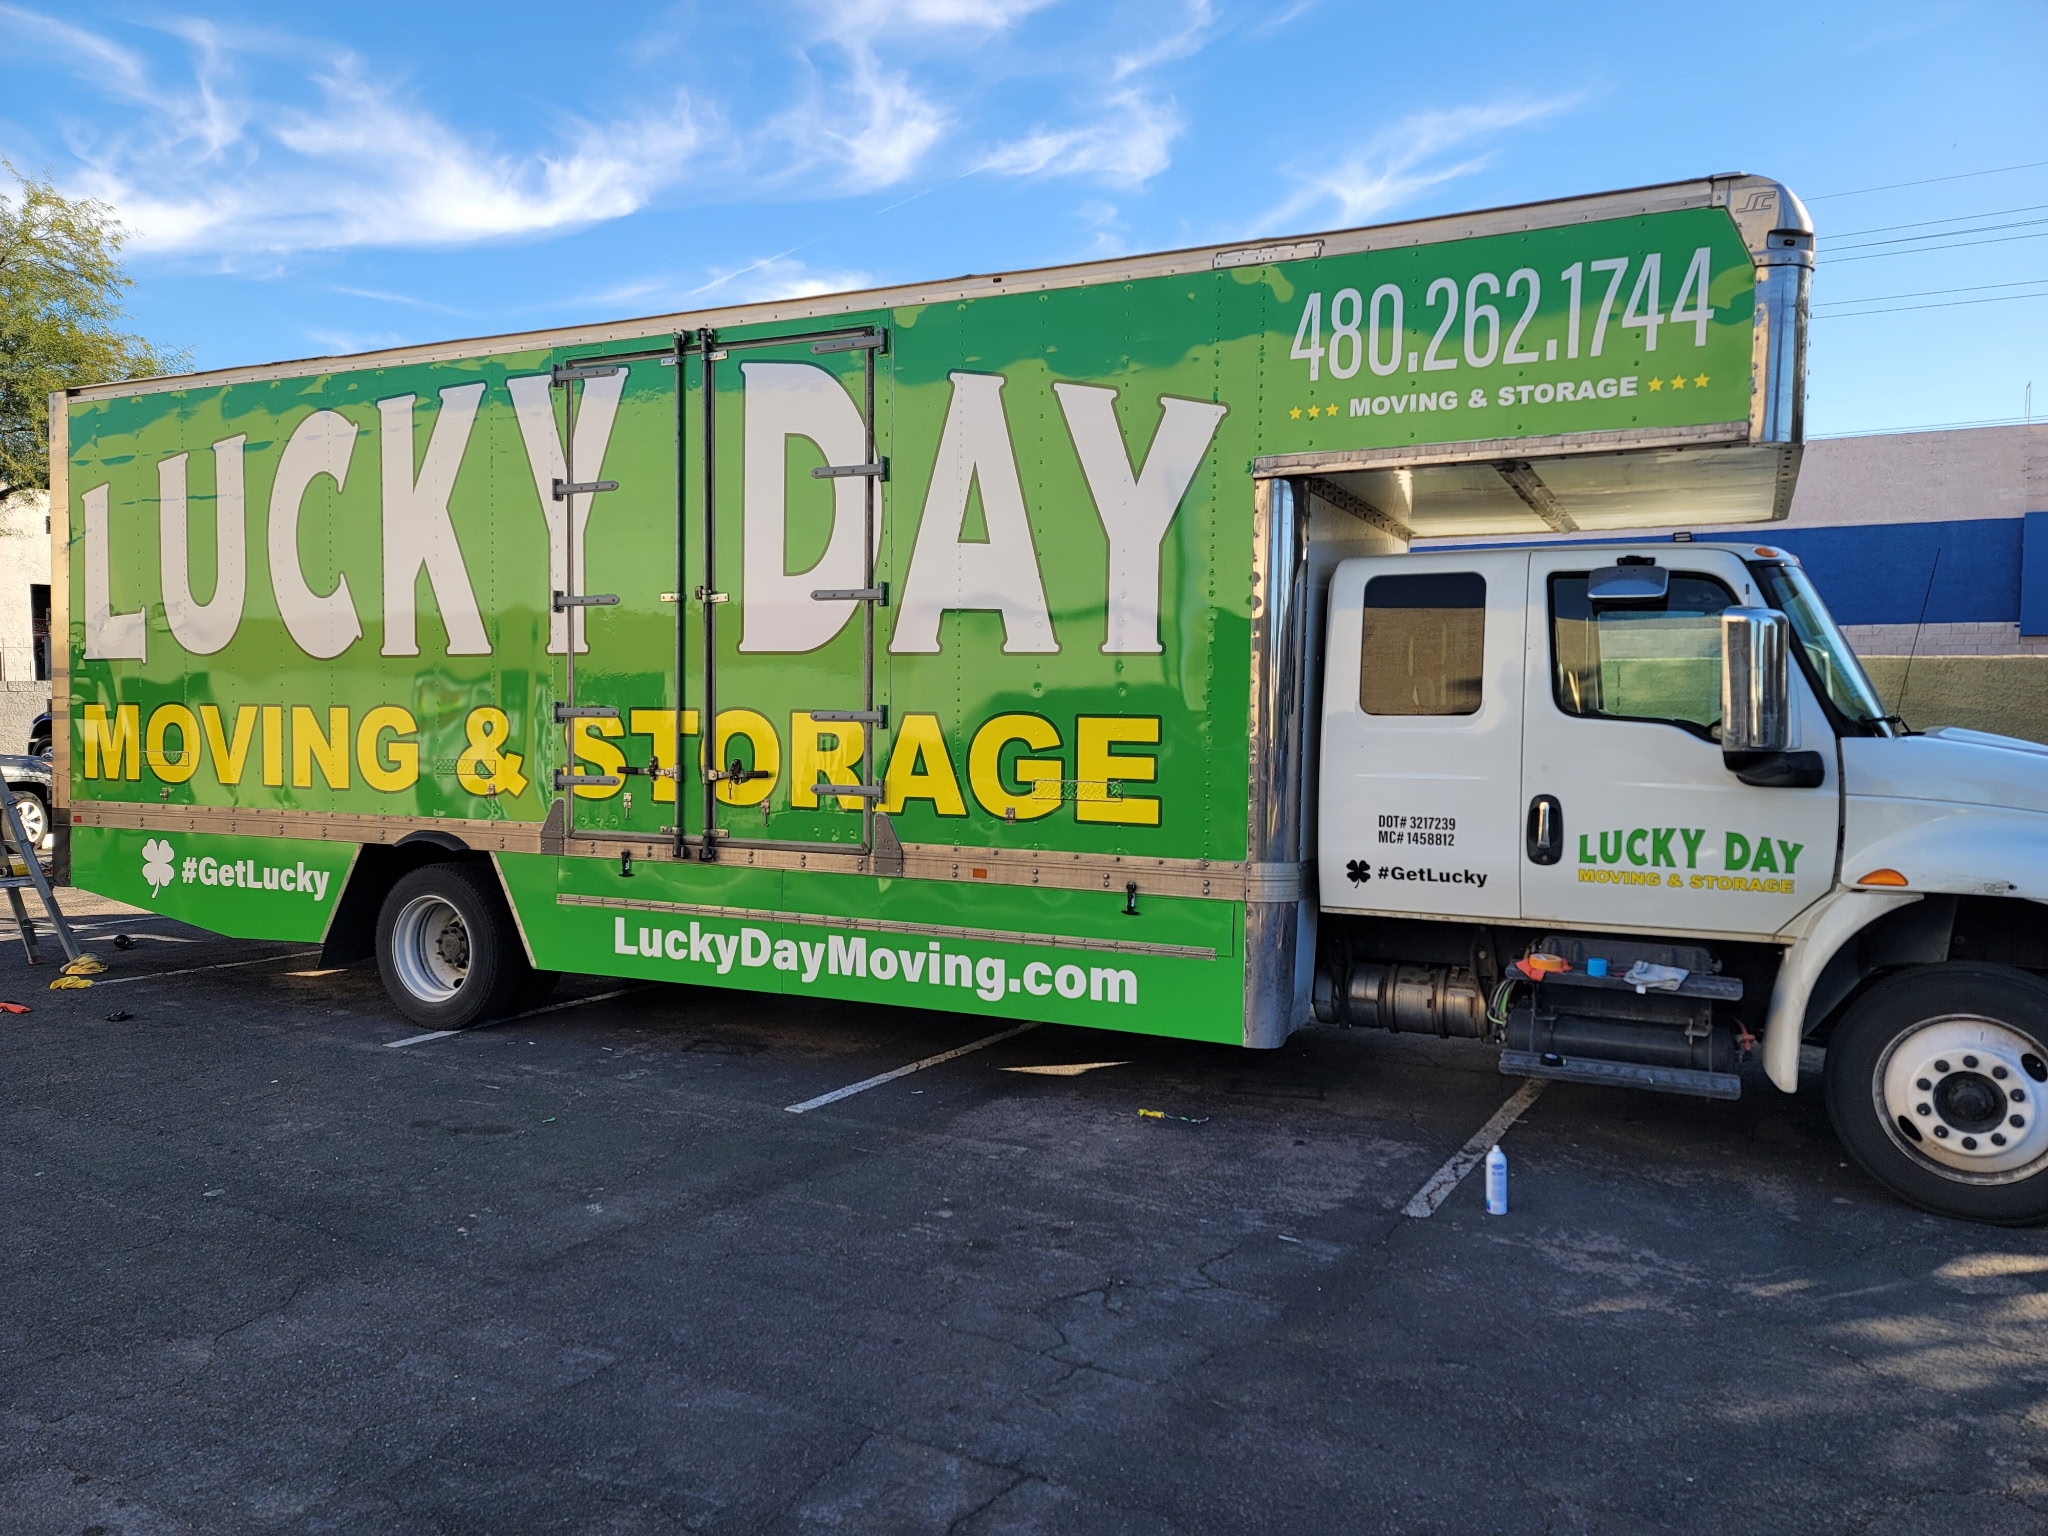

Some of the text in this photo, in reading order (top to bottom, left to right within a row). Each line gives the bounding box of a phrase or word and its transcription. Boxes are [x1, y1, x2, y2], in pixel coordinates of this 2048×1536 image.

[1289, 246, 1715, 382] 480.262.1744
[1349, 376, 1639, 418] MOVING & STORAGE
[81, 361, 1230, 664] LUCKY DAY
[82, 703, 1162, 828] MOVING & STORAGE
[1378, 815, 1456, 831] DOT# 3217239
[1378, 830, 1455, 847] MC# 1458812
[1578, 827, 1805, 874] LUCKY DAY
[181, 855, 330, 902] #GetLucky
[1377, 865, 1488, 888] #GetLucky
[1578, 868, 1795, 894] MOVING & STORAGE
[613, 916, 1139, 1007] LuckyDayMoving.com
